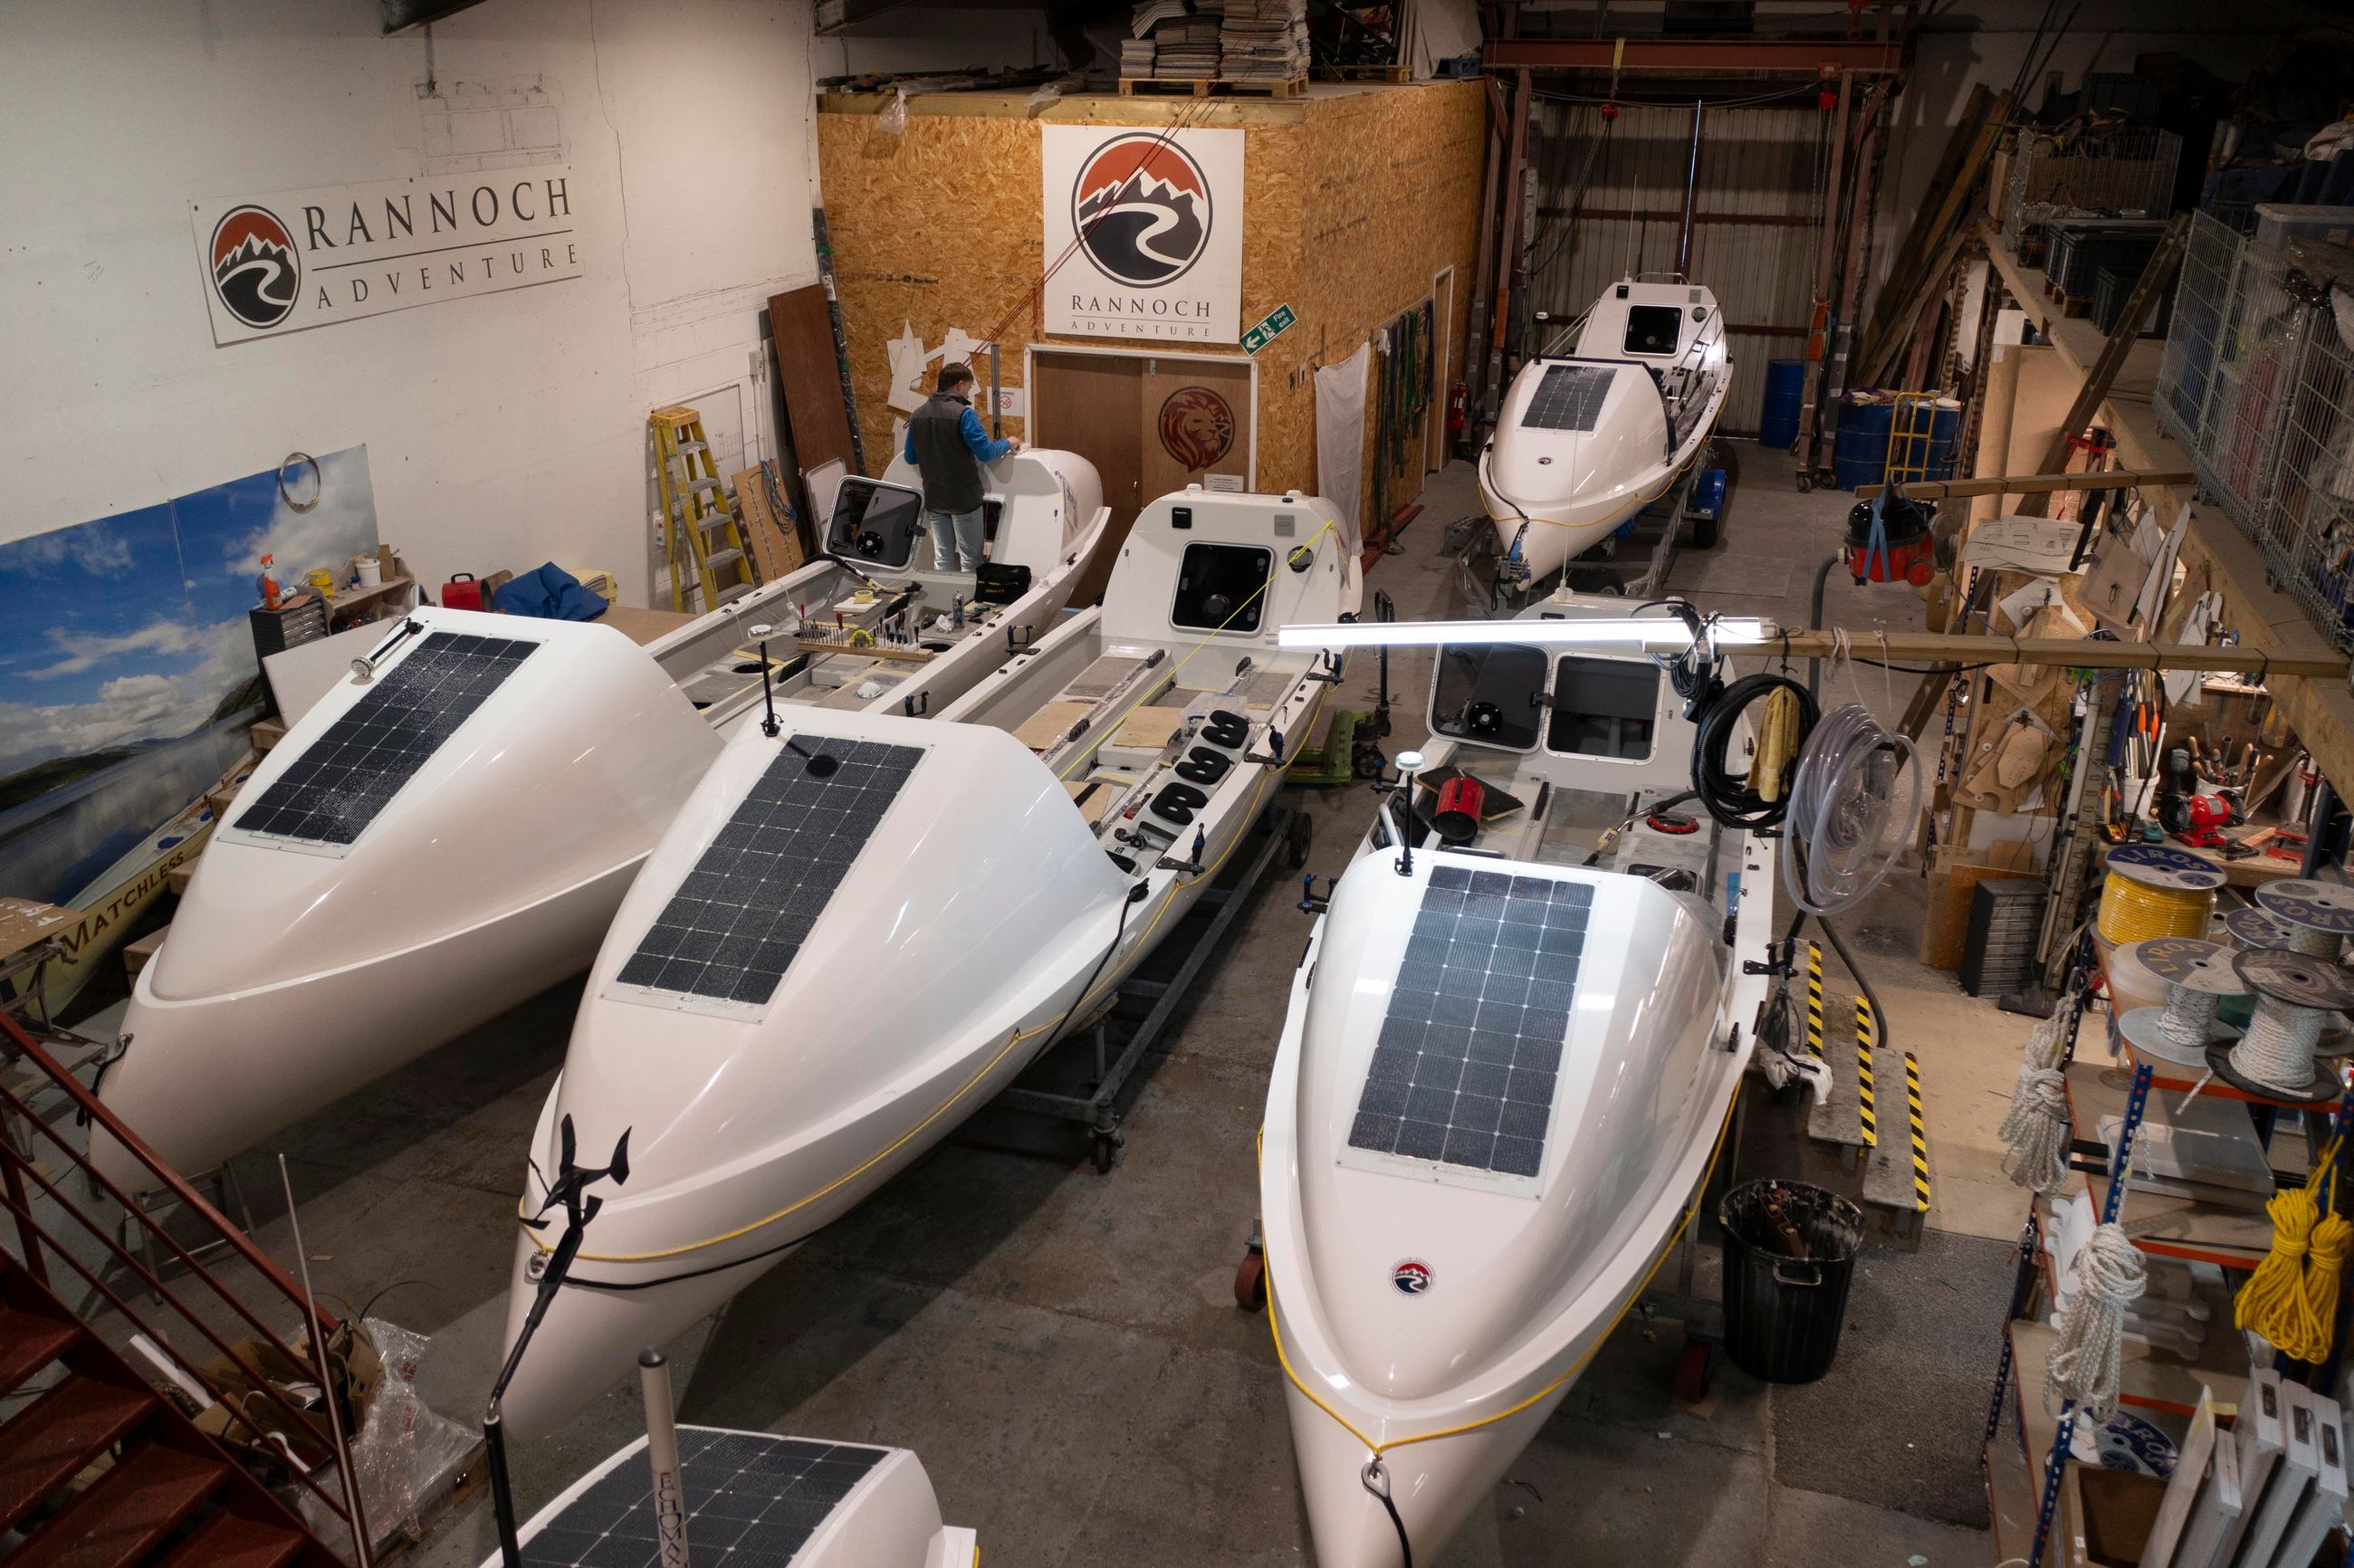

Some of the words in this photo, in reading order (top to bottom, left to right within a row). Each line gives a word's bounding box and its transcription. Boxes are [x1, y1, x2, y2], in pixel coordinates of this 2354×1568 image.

[301, 177, 572, 252] RANNOCH
[317, 244, 578, 310] ADVENTURE
[1071, 294, 1210, 318] RANNOCH
[1273, 311, 1287, 322] Fire
[1071, 320, 1210, 337] ADVENTURE
[1278, 317, 1291, 328] exit
[2117, 848, 2209, 870] LIROS
[58, 851, 185, 955] MATCHLESS
[2269, 897, 2354, 929] IROS
[2147, 942, 2205, 973] LIROS
[658, 1471, 683, 1565] ECHOMAX
